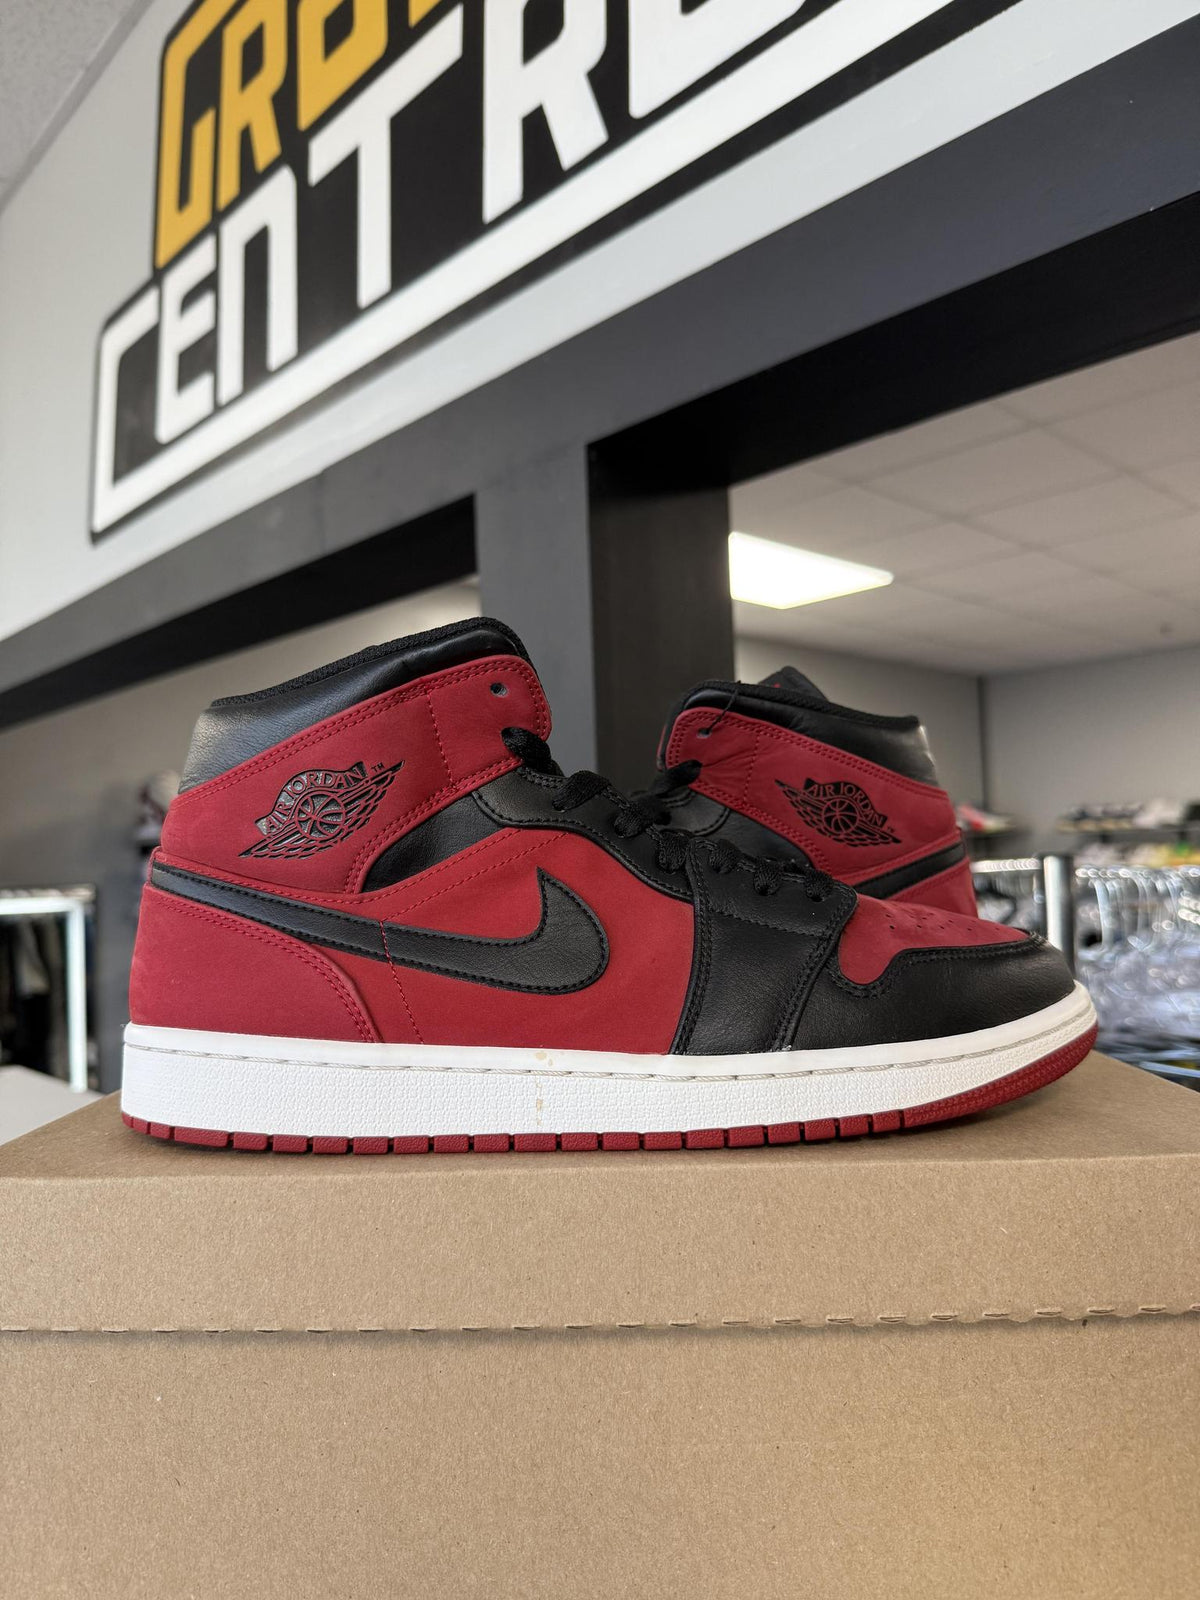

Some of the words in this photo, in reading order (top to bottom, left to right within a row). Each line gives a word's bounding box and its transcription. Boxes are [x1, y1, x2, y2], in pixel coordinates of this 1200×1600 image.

[155, 0, 442, 270] GRO
[264, 800, 293, 833] AIR
[283, 766, 364, 799] JORDAN
[808, 783, 836, 797] AIR
[840, 782, 884, 828] JORDAN
